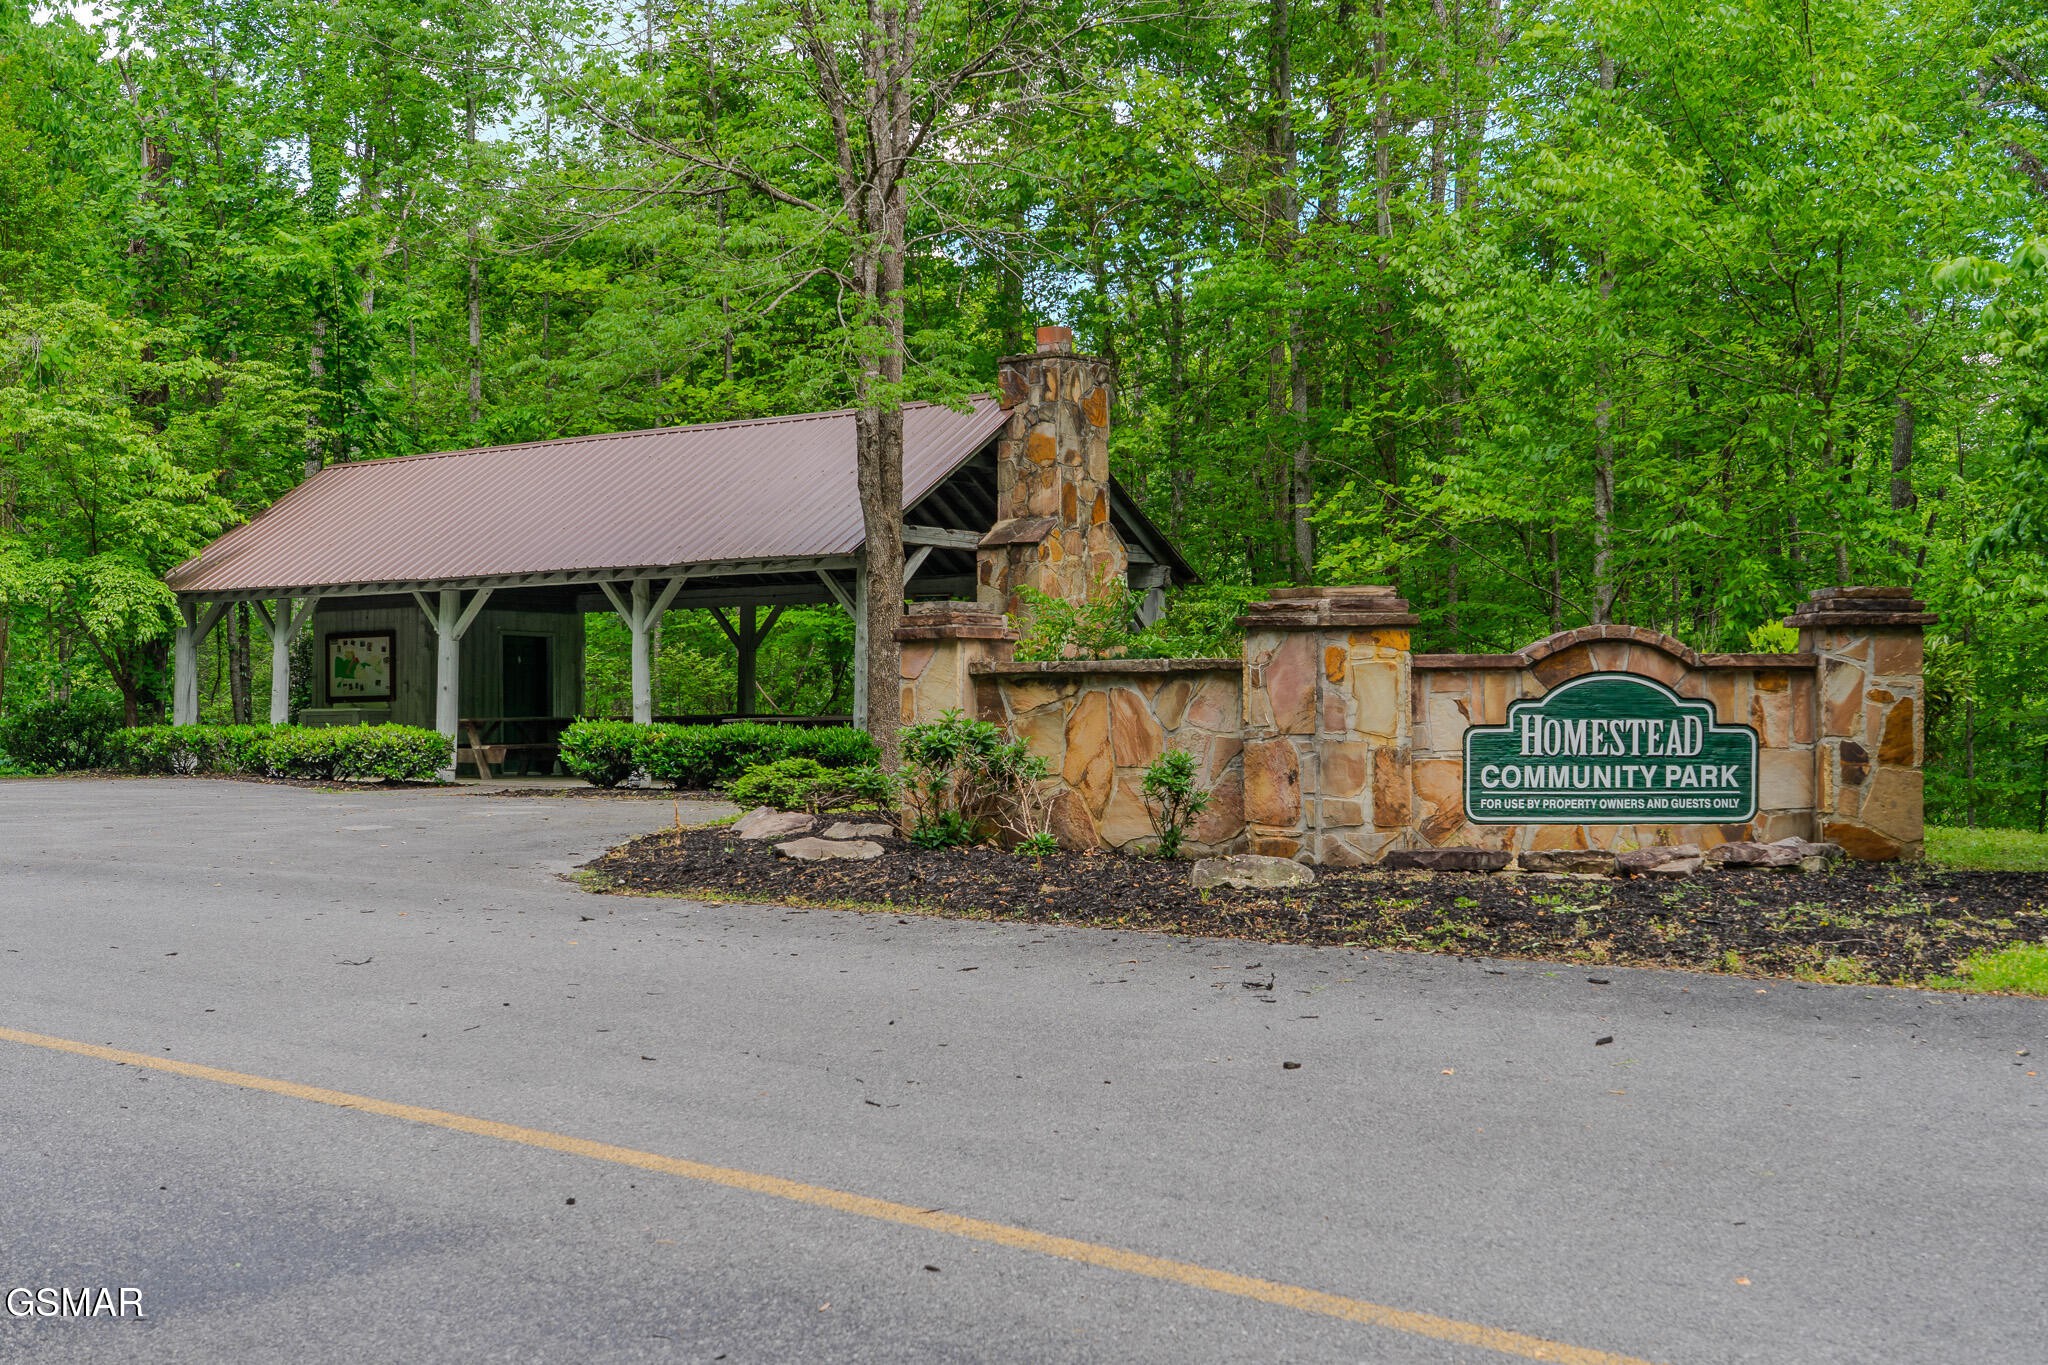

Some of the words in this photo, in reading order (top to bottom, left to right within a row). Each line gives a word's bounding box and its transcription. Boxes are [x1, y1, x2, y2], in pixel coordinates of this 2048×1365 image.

[1519, 714, 1704, 757] HOMESTEAD
[1481, 764, 1658, 788] COMMUNITY
[1665, 764, 1740, 788] PARK
[1480, 798, 1502, 809] FOR
[1504, 798, 1525, 809] USE
[1527, 798, 1541, 809] BY
[1542, 798, 1598, 809] PROPERTY
[1599, 798, 1645, 809] OWNERS
[1647, 798, 1669, 809] AND
[1671, 798, 1711, 809] GUESTS
[1713, 798, 1740, 809] ONLY
